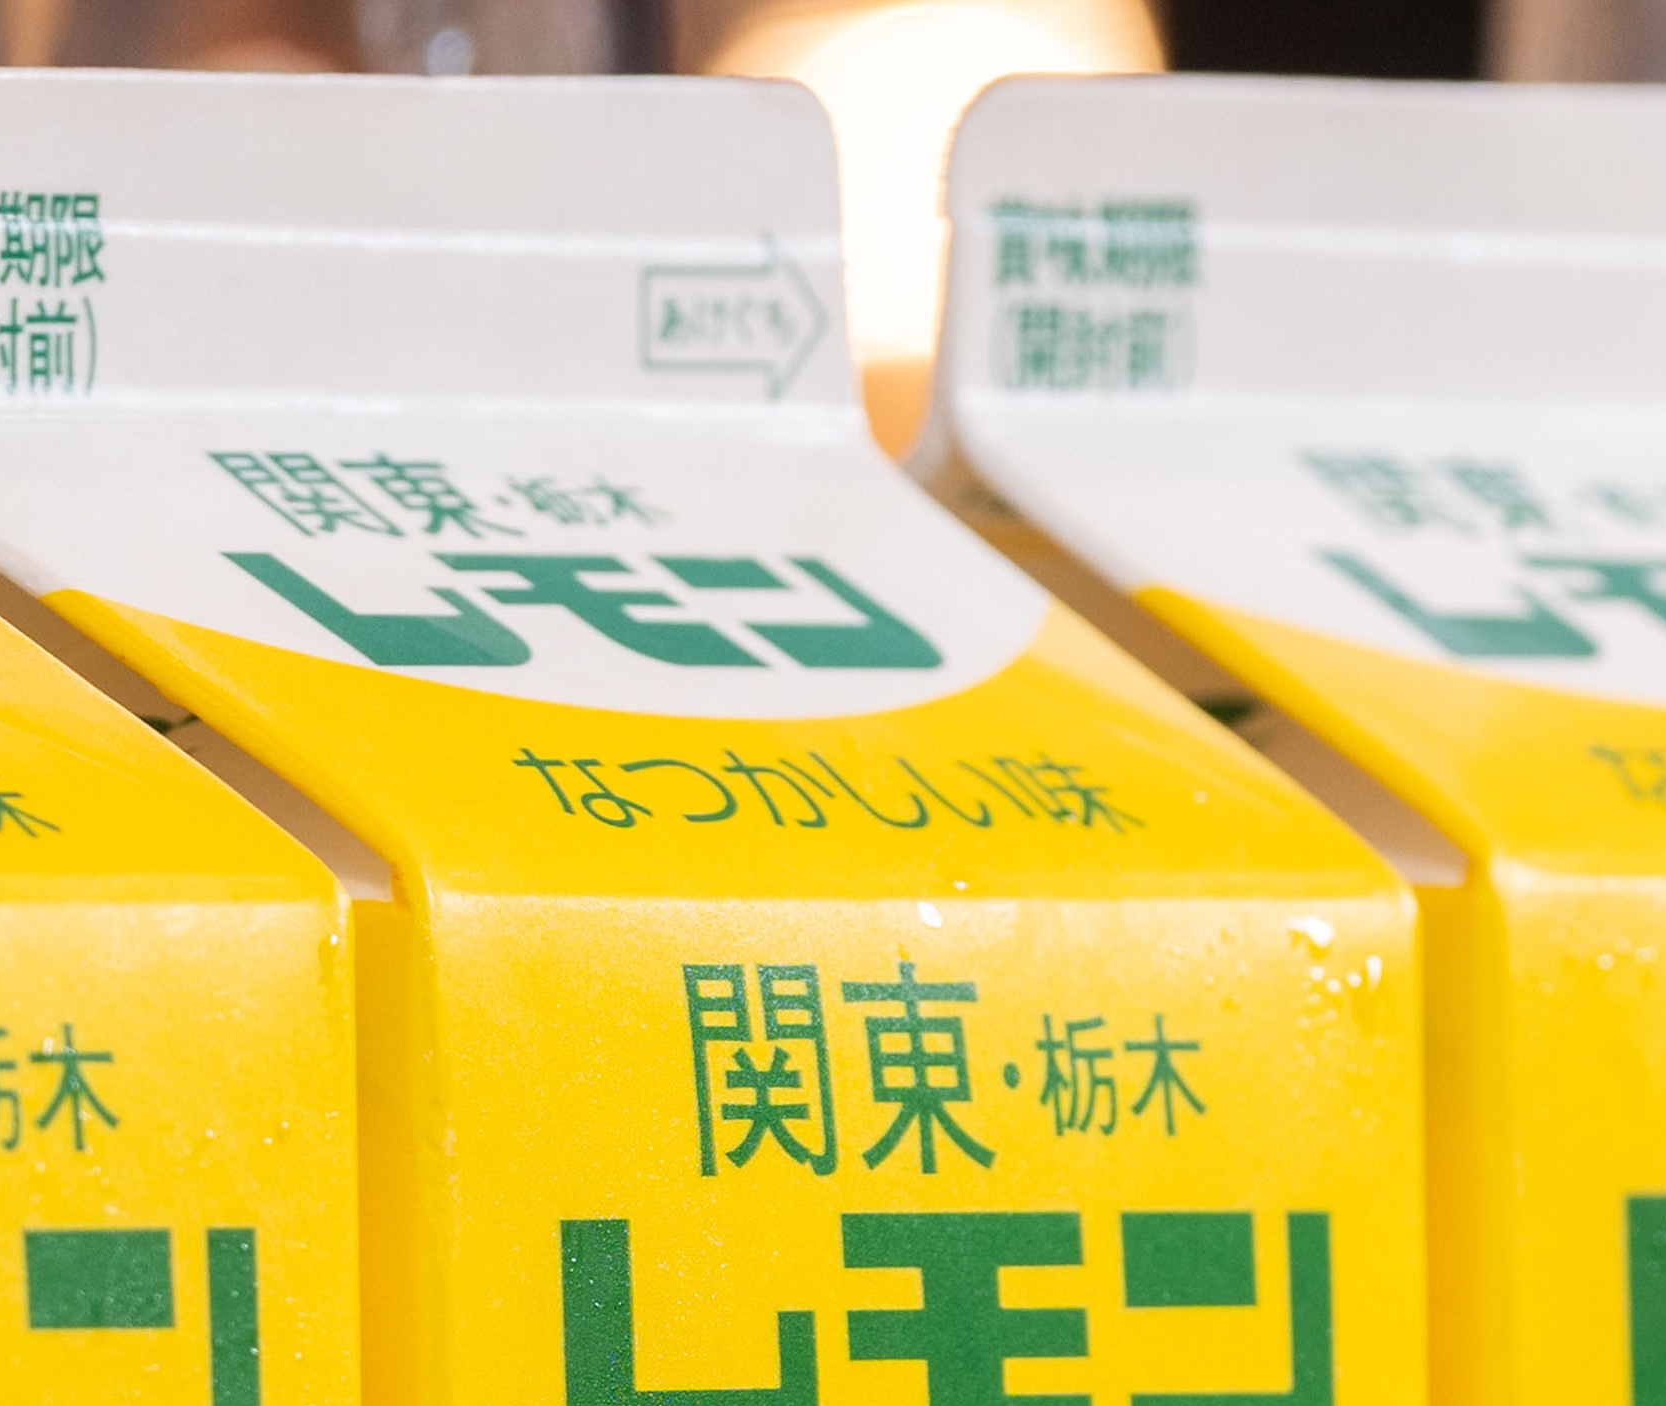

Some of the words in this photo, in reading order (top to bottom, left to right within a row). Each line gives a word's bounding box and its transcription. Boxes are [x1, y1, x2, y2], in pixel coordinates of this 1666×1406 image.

[219, 551, 943, 670] レモン
[512, 748, 1146, 834] なつかしい味
[681, 961, 1205, 1177] 関東・栃木
